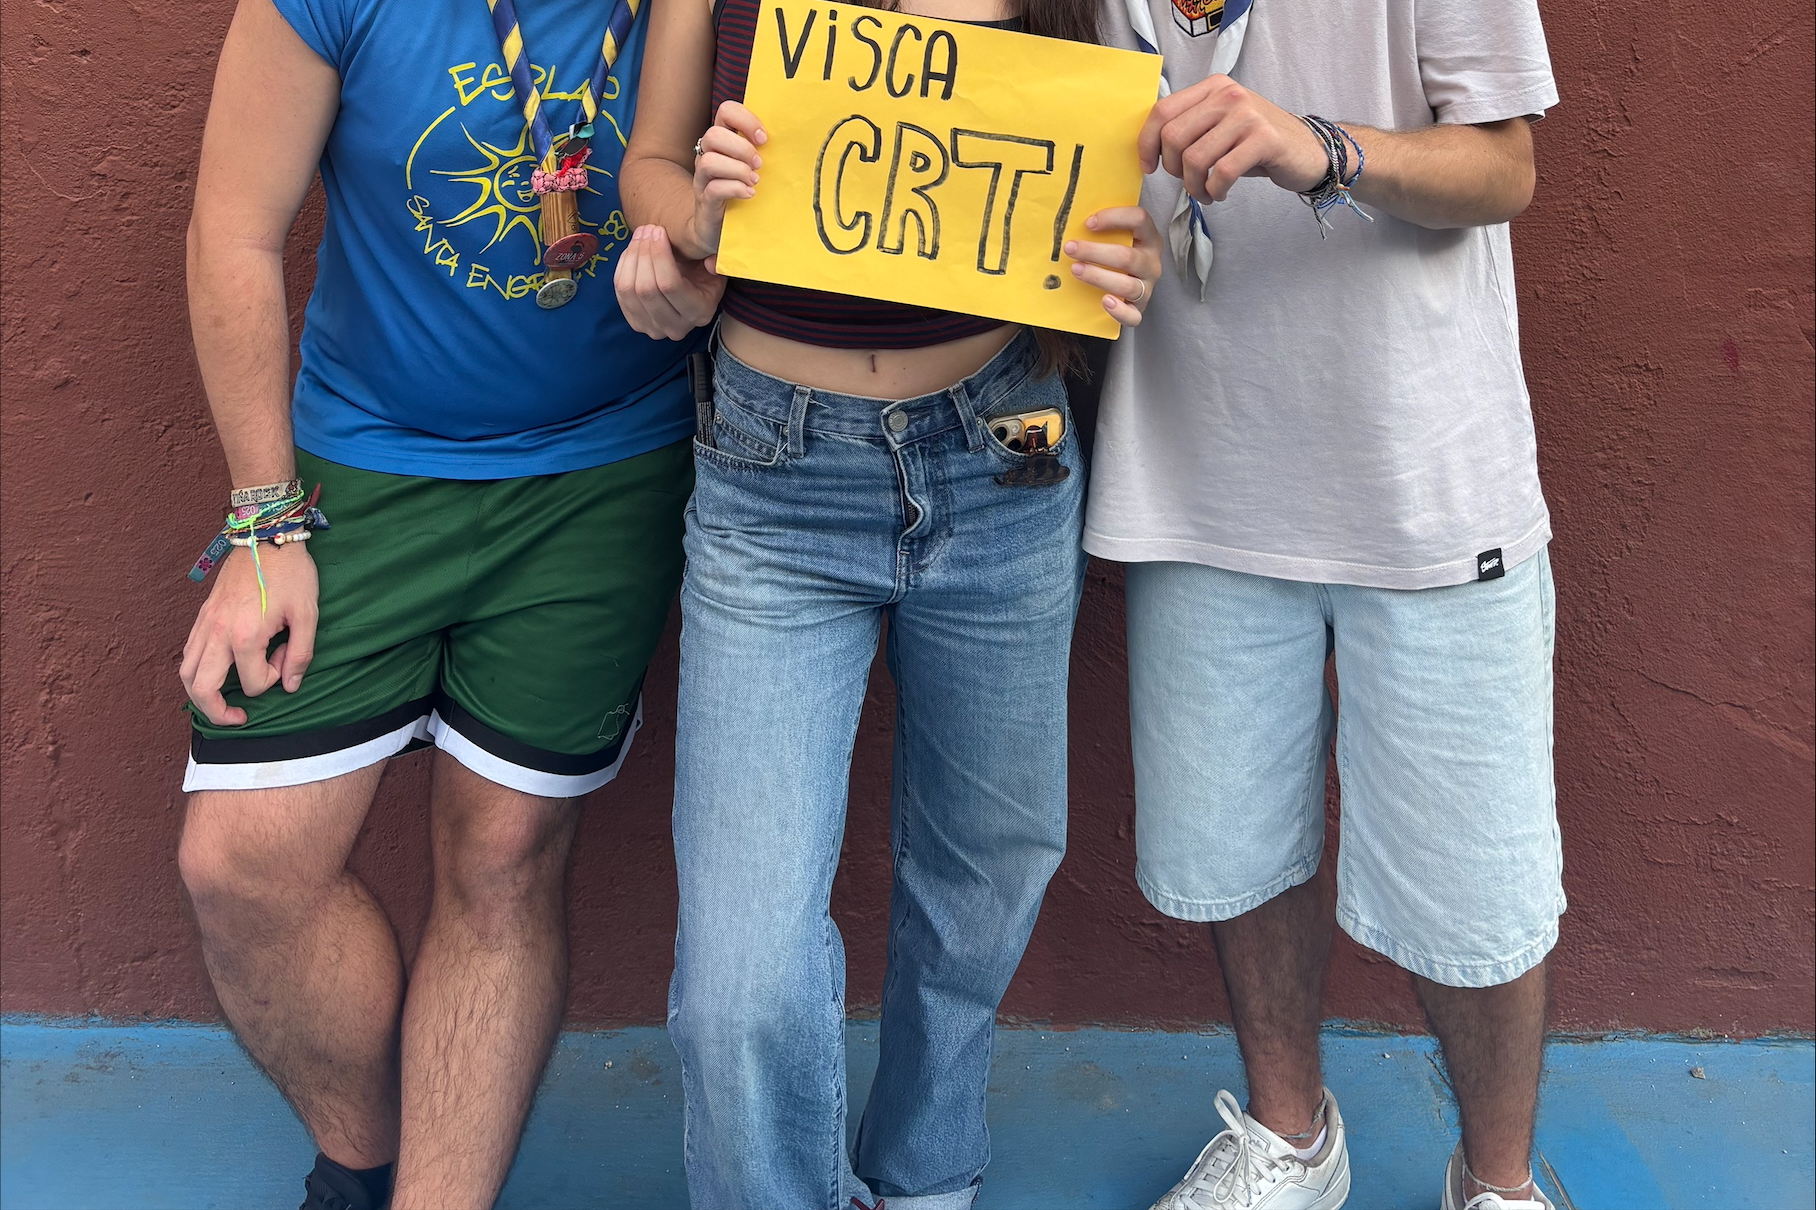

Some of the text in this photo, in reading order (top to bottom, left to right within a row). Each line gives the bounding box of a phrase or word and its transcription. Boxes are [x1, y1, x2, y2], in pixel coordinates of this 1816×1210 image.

[813, 114, 1085, 291] CRT!
[555, 252, 577, 261] ZONA
[210, 539, 227, 557] 025
